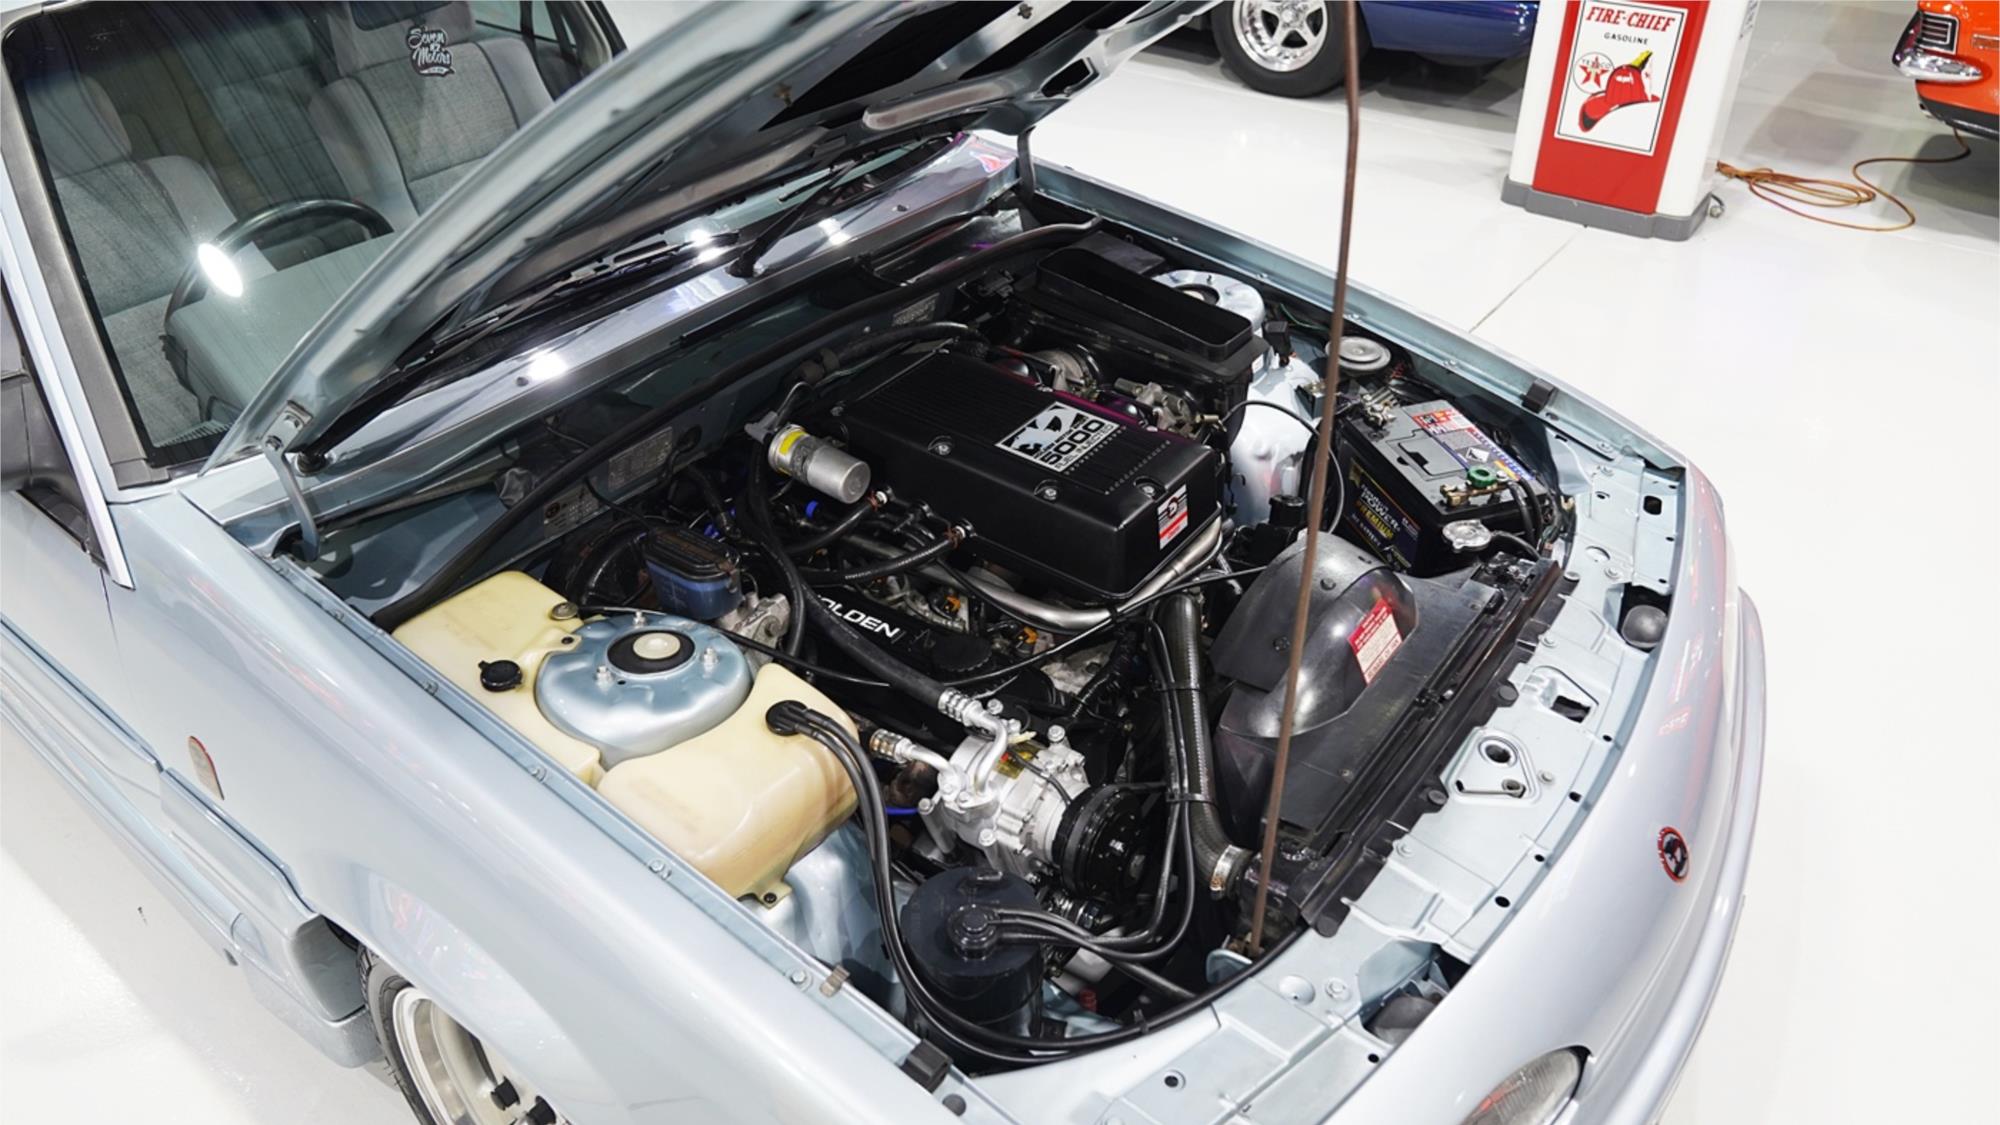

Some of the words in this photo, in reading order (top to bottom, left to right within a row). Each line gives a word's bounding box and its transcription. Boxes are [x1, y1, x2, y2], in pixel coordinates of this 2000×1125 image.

[1586, 6, 1676, 32] FIRE-CHIEF
[408, 28, 445, 49] Seven
[1604, 32, 1649, 45] GASOLINE
[412, 47, 451, 67] Motors
[1040, 419, 1106, 465] 5000
[1356, 500, 1394, 539] PREMIUM
[817, 594, 900, 638] OLDEN
